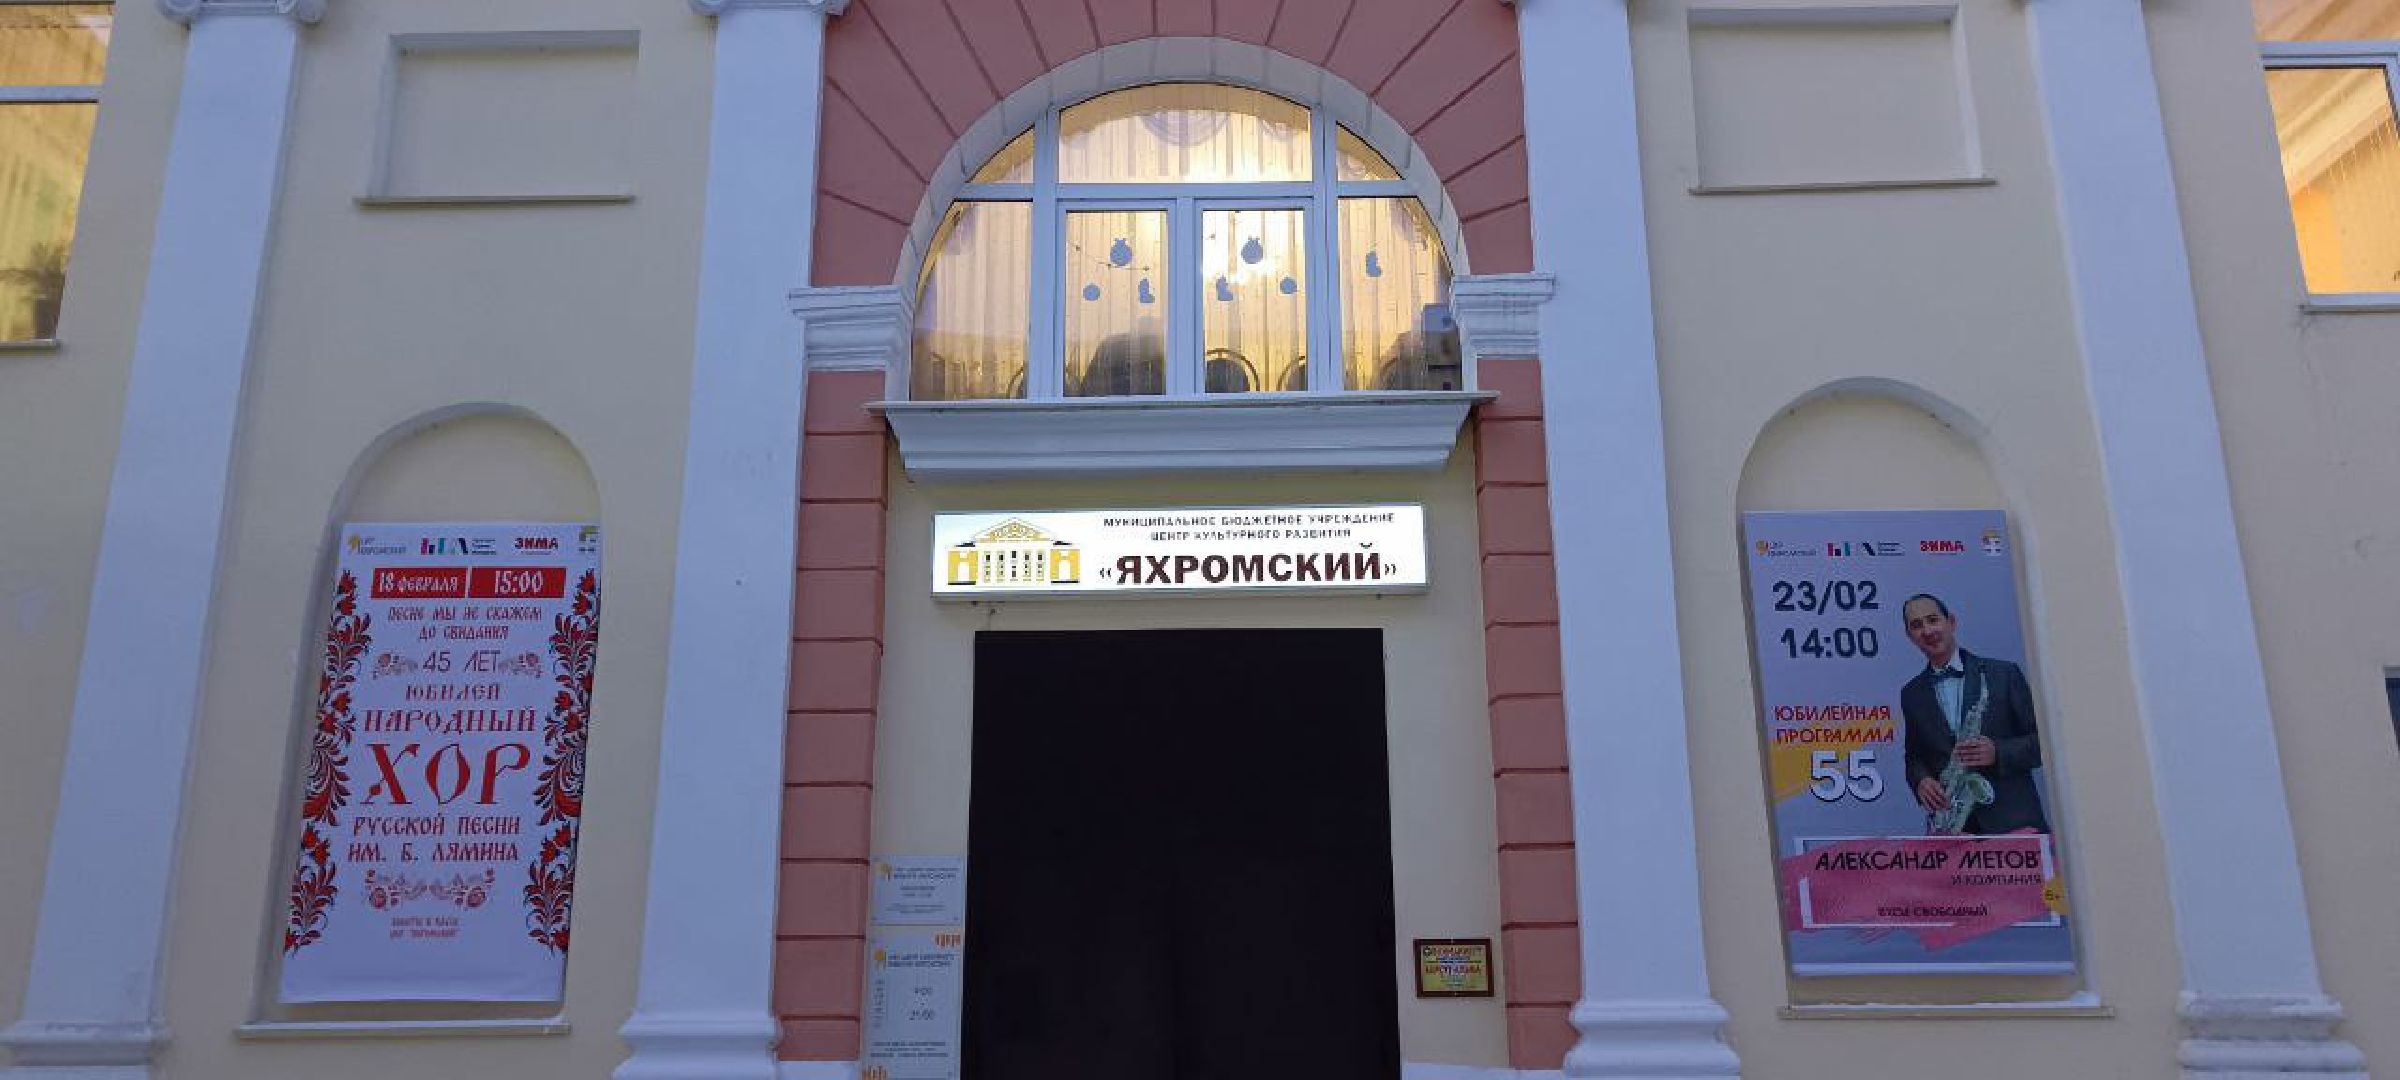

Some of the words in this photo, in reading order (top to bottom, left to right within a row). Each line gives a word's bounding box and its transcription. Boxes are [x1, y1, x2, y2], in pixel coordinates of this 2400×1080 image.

[1103, 516, 1216, 527] МУНИЦИПАЛЬНОЕ
[1221, 515, 1302, 526] БЮДЖЕТНОЕ
[1308, 513, 1395, 524] УЧРЕЖДЕНИЕ
[514, 537, 558, 550] ЗИМА
[1151, 531, 1190, 541] ЦЕНТР
[1194, 530, 1280, 541] КУЛЬТУРНОГО
[1285, 529, 1351, 539] РАЗВИТИЯ
[1919, 540, 1964, 552] ЗИМА
[1100, 542, 1397, 585] «ЯХРОМСКИЙ»
[379, 571, 394, 593] 18
[397, 576, 459, 592] ФЕВРАЛЯ
[494, 571, 543, 594] 15:00
[1772, 580, 1879, 616] 23/02
[432, 606, 456, 621] МЫ
[463, 607, 477, 620] НЕ
[486, 606, 542, 621] СКАЖЕМ
[419, 625, 437, 642] ДО
[443, 625, 509, 641] СВИДАНИЯ
[1780, 627, 1879, 659] 14:00
[422, 650, 451, 672] 45
[464, 650, 501, 672] ЛЕТ
[363, 705, 537, 735] НАРОДНЫЙ
[1774, 702, 1891, 721] ЮБИЛЕЙНАЯ
[1776, 728, 1894, 744] ПРОГРАММА
[360, 743, 531, 805] ХОР
[1809, 751, 1885, 803] 55
[352, 813, 445, 837] РУССКОЙ
[458, 816, 520, 836] ПЕСНИ
[347, 842, 387, 862] ИМ.
[400, 842, 419, 862] Б.
[432, 842, 519, 862] ЛЯМИНА
[1815, 850, 1949, 871] АЛЕКСАНДР
[1959, 850, 2040, 870] МЕТОВ
[1965, 874, 2042, 886] КОМПАНИЯ
